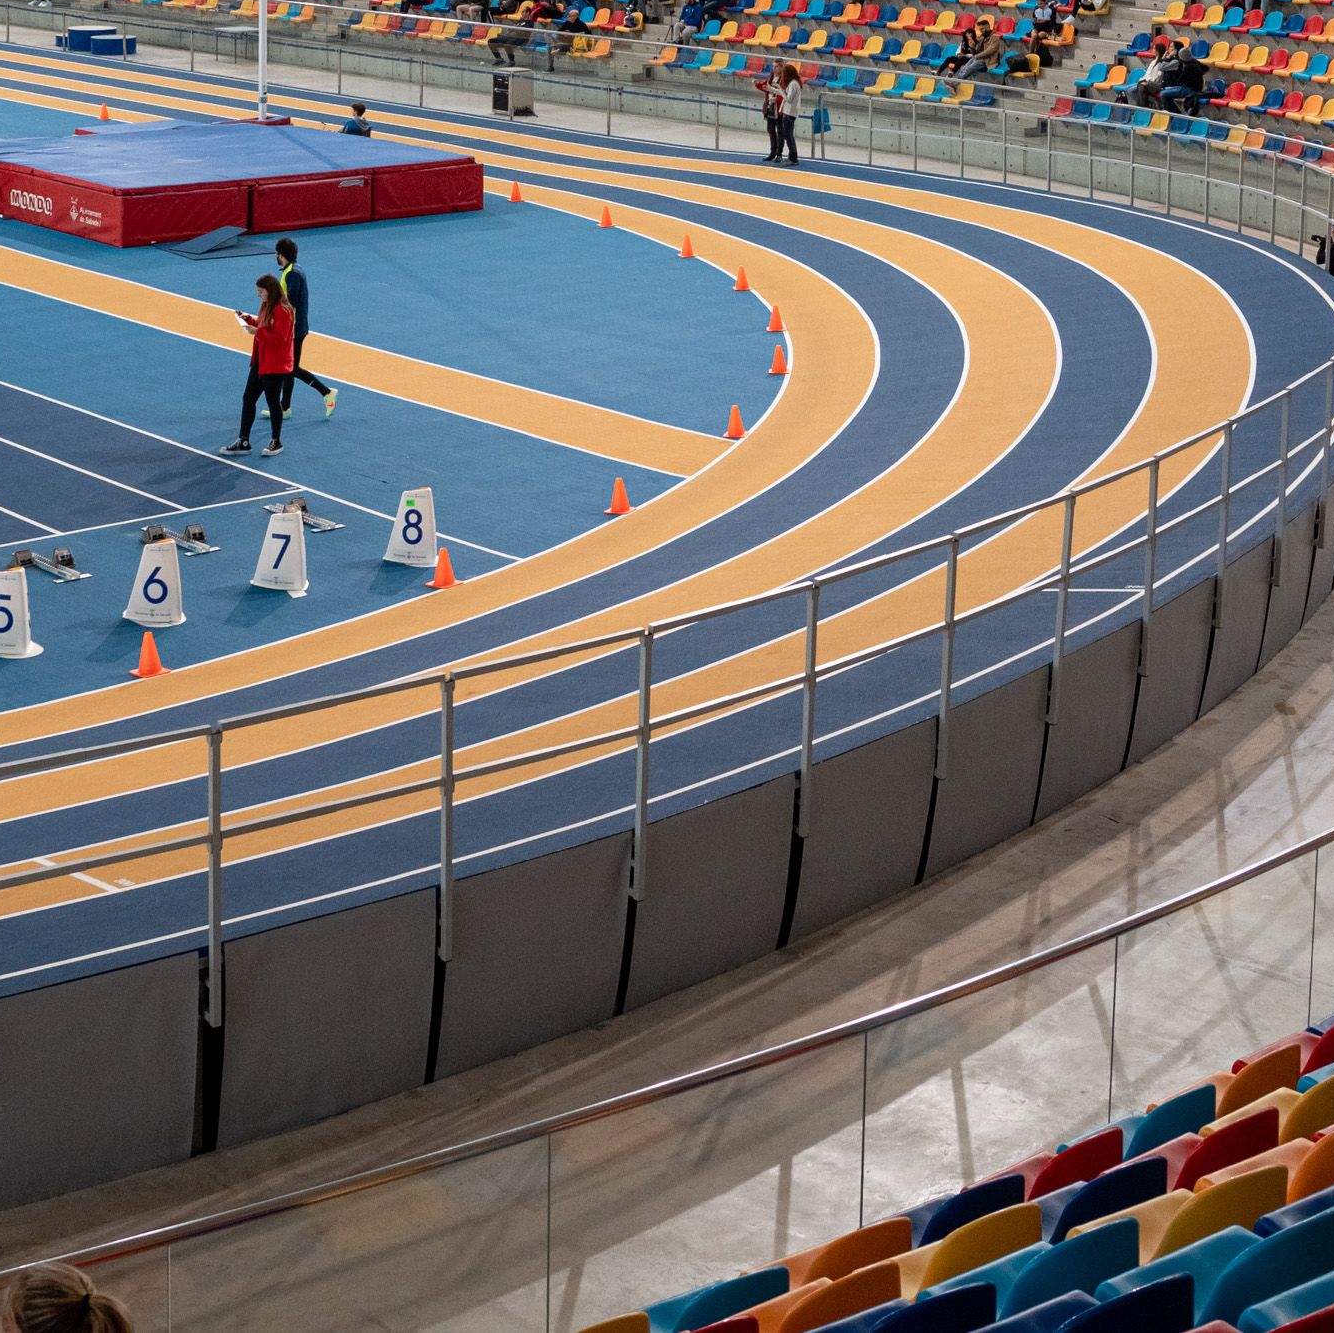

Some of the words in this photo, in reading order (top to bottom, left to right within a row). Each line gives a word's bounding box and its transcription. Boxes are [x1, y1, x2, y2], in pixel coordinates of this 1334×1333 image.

[10, 189, 53, 216] MONDO
[402, 509, 423, 545] 8
[272, 533, 292, 570] 7
[143, 566, 169, 604] 6
